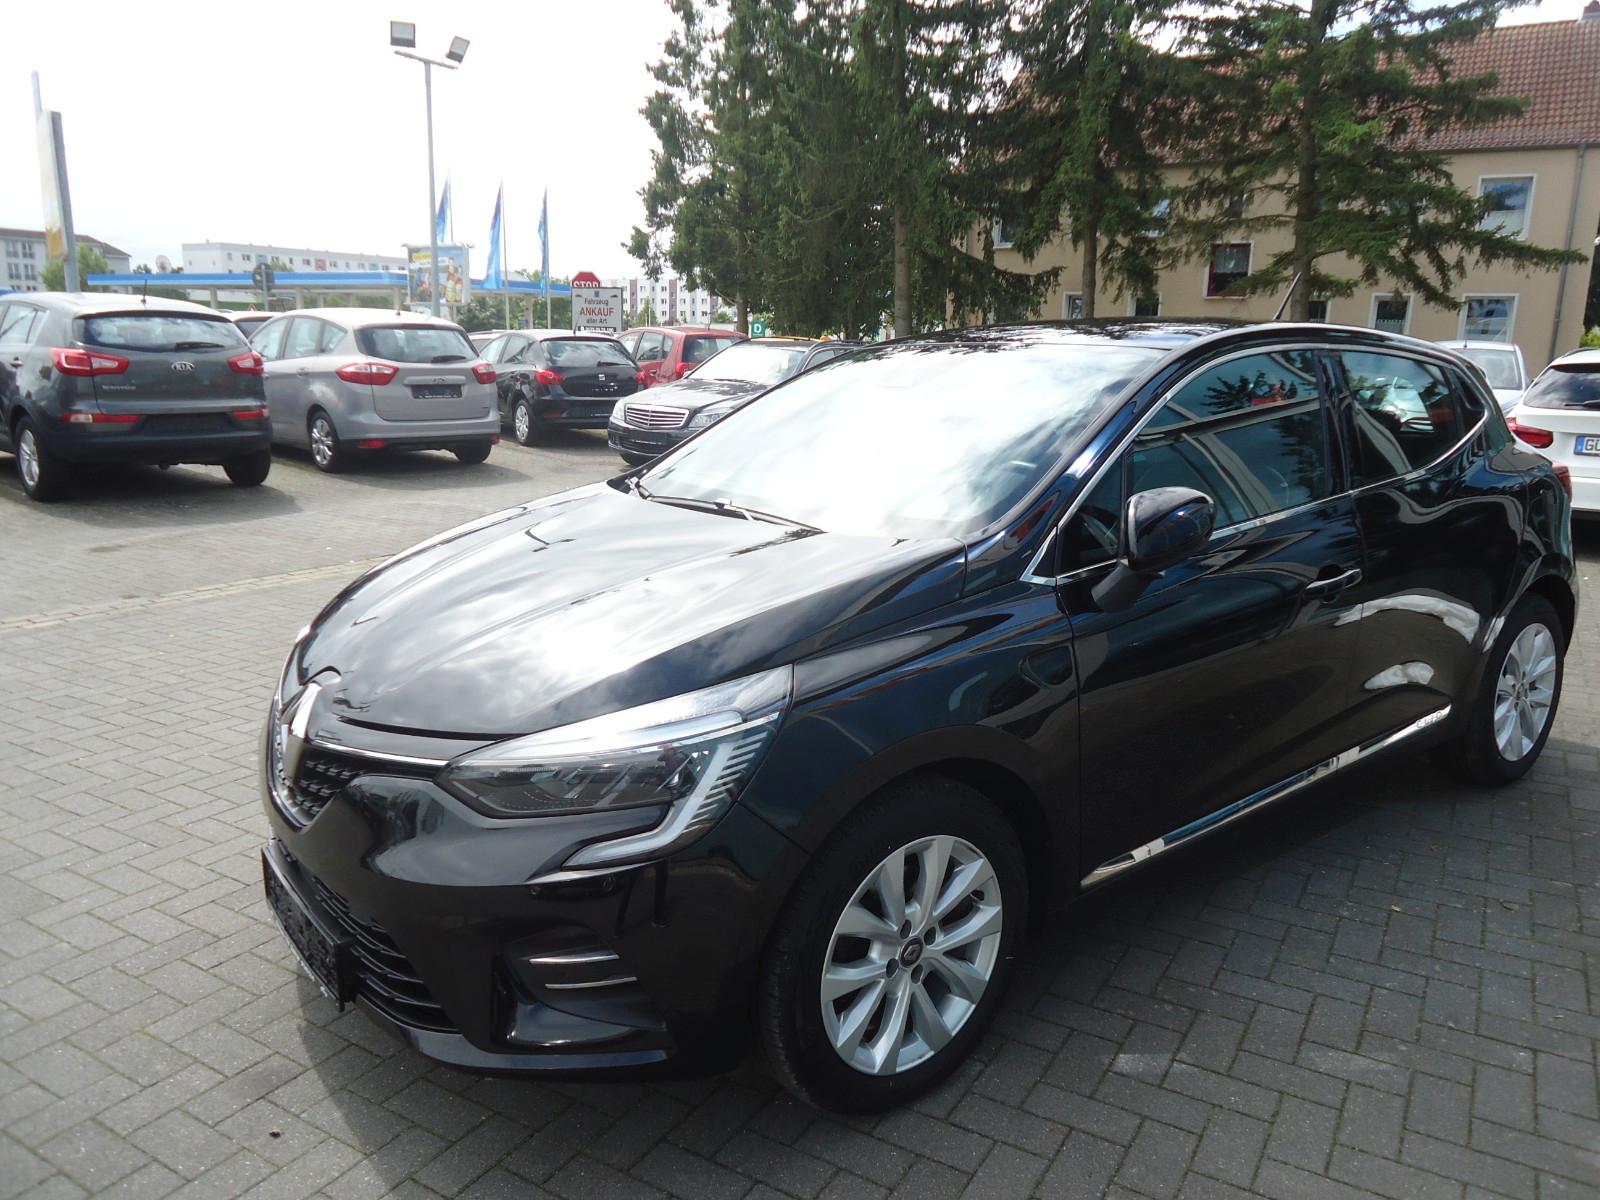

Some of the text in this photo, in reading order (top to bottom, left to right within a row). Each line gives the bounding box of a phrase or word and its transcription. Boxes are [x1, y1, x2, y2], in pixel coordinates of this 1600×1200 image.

[585, 298, 608, 306] Fahrzeug
[580, 307, 614, 316] ANKAUF
[753, 323, 762, 333] D
